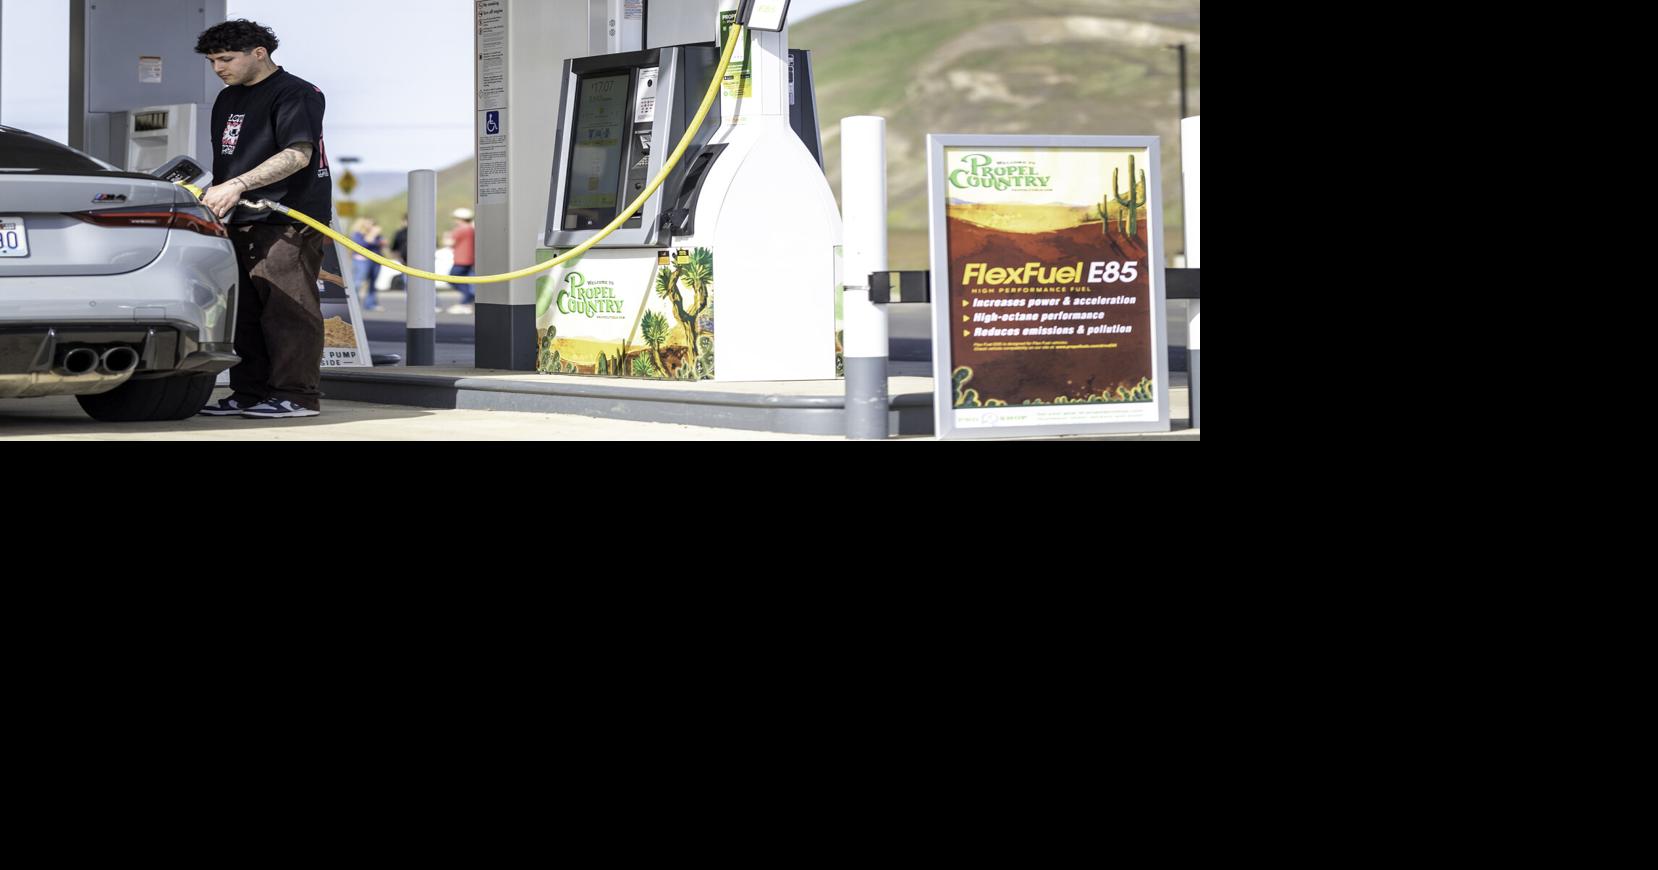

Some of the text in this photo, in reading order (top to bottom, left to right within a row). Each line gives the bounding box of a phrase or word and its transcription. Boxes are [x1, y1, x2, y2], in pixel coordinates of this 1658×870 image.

[961, 154, 1039, 177] PROPEL
[948, 168, 1051, 191] COUNTRY
[962, 260, 1138, 286] FlexFuel E85
[564, 271, 616, 299] PROPEL
[998, 286, 1067, 294] PERFORMANCE
[556, 289, 624, 318] COUNTRY
[972, 295, 1137, 309] Increases power & acceleration
[973, 311, 1105, 323] High-octane performance
[973, 323, 1133, 337] Reduces emissions & pollution
[329, 351, 356, 359] PUMP
